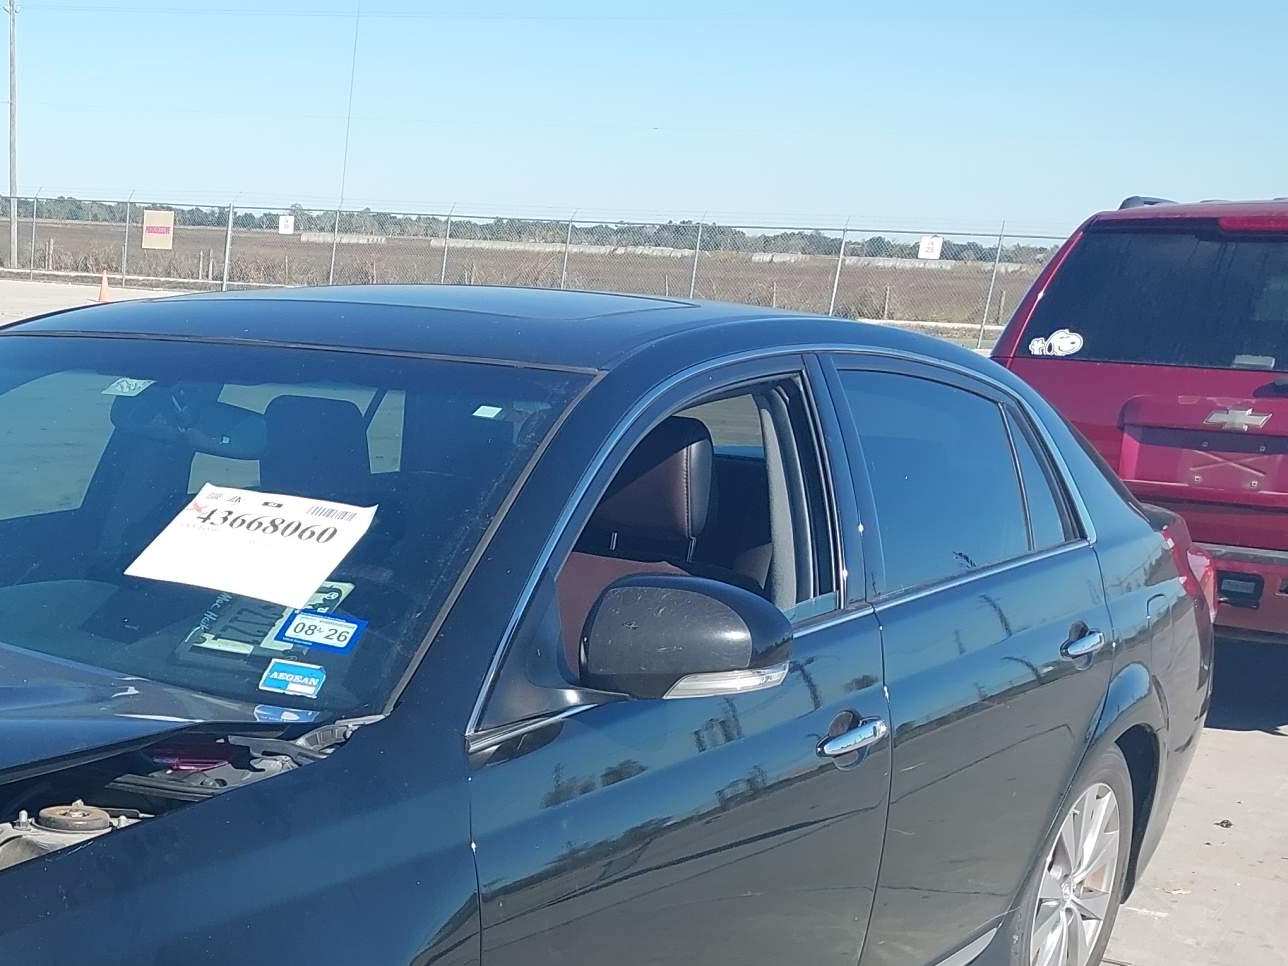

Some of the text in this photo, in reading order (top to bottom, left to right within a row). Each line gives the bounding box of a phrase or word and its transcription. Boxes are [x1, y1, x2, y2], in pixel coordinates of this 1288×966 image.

[197, 508, 338, 544] 43668060
[293, 622, 318, 636] 08
[323, 628, 350, 642] 26
[269, 671, 320, 686] AEGEAN
